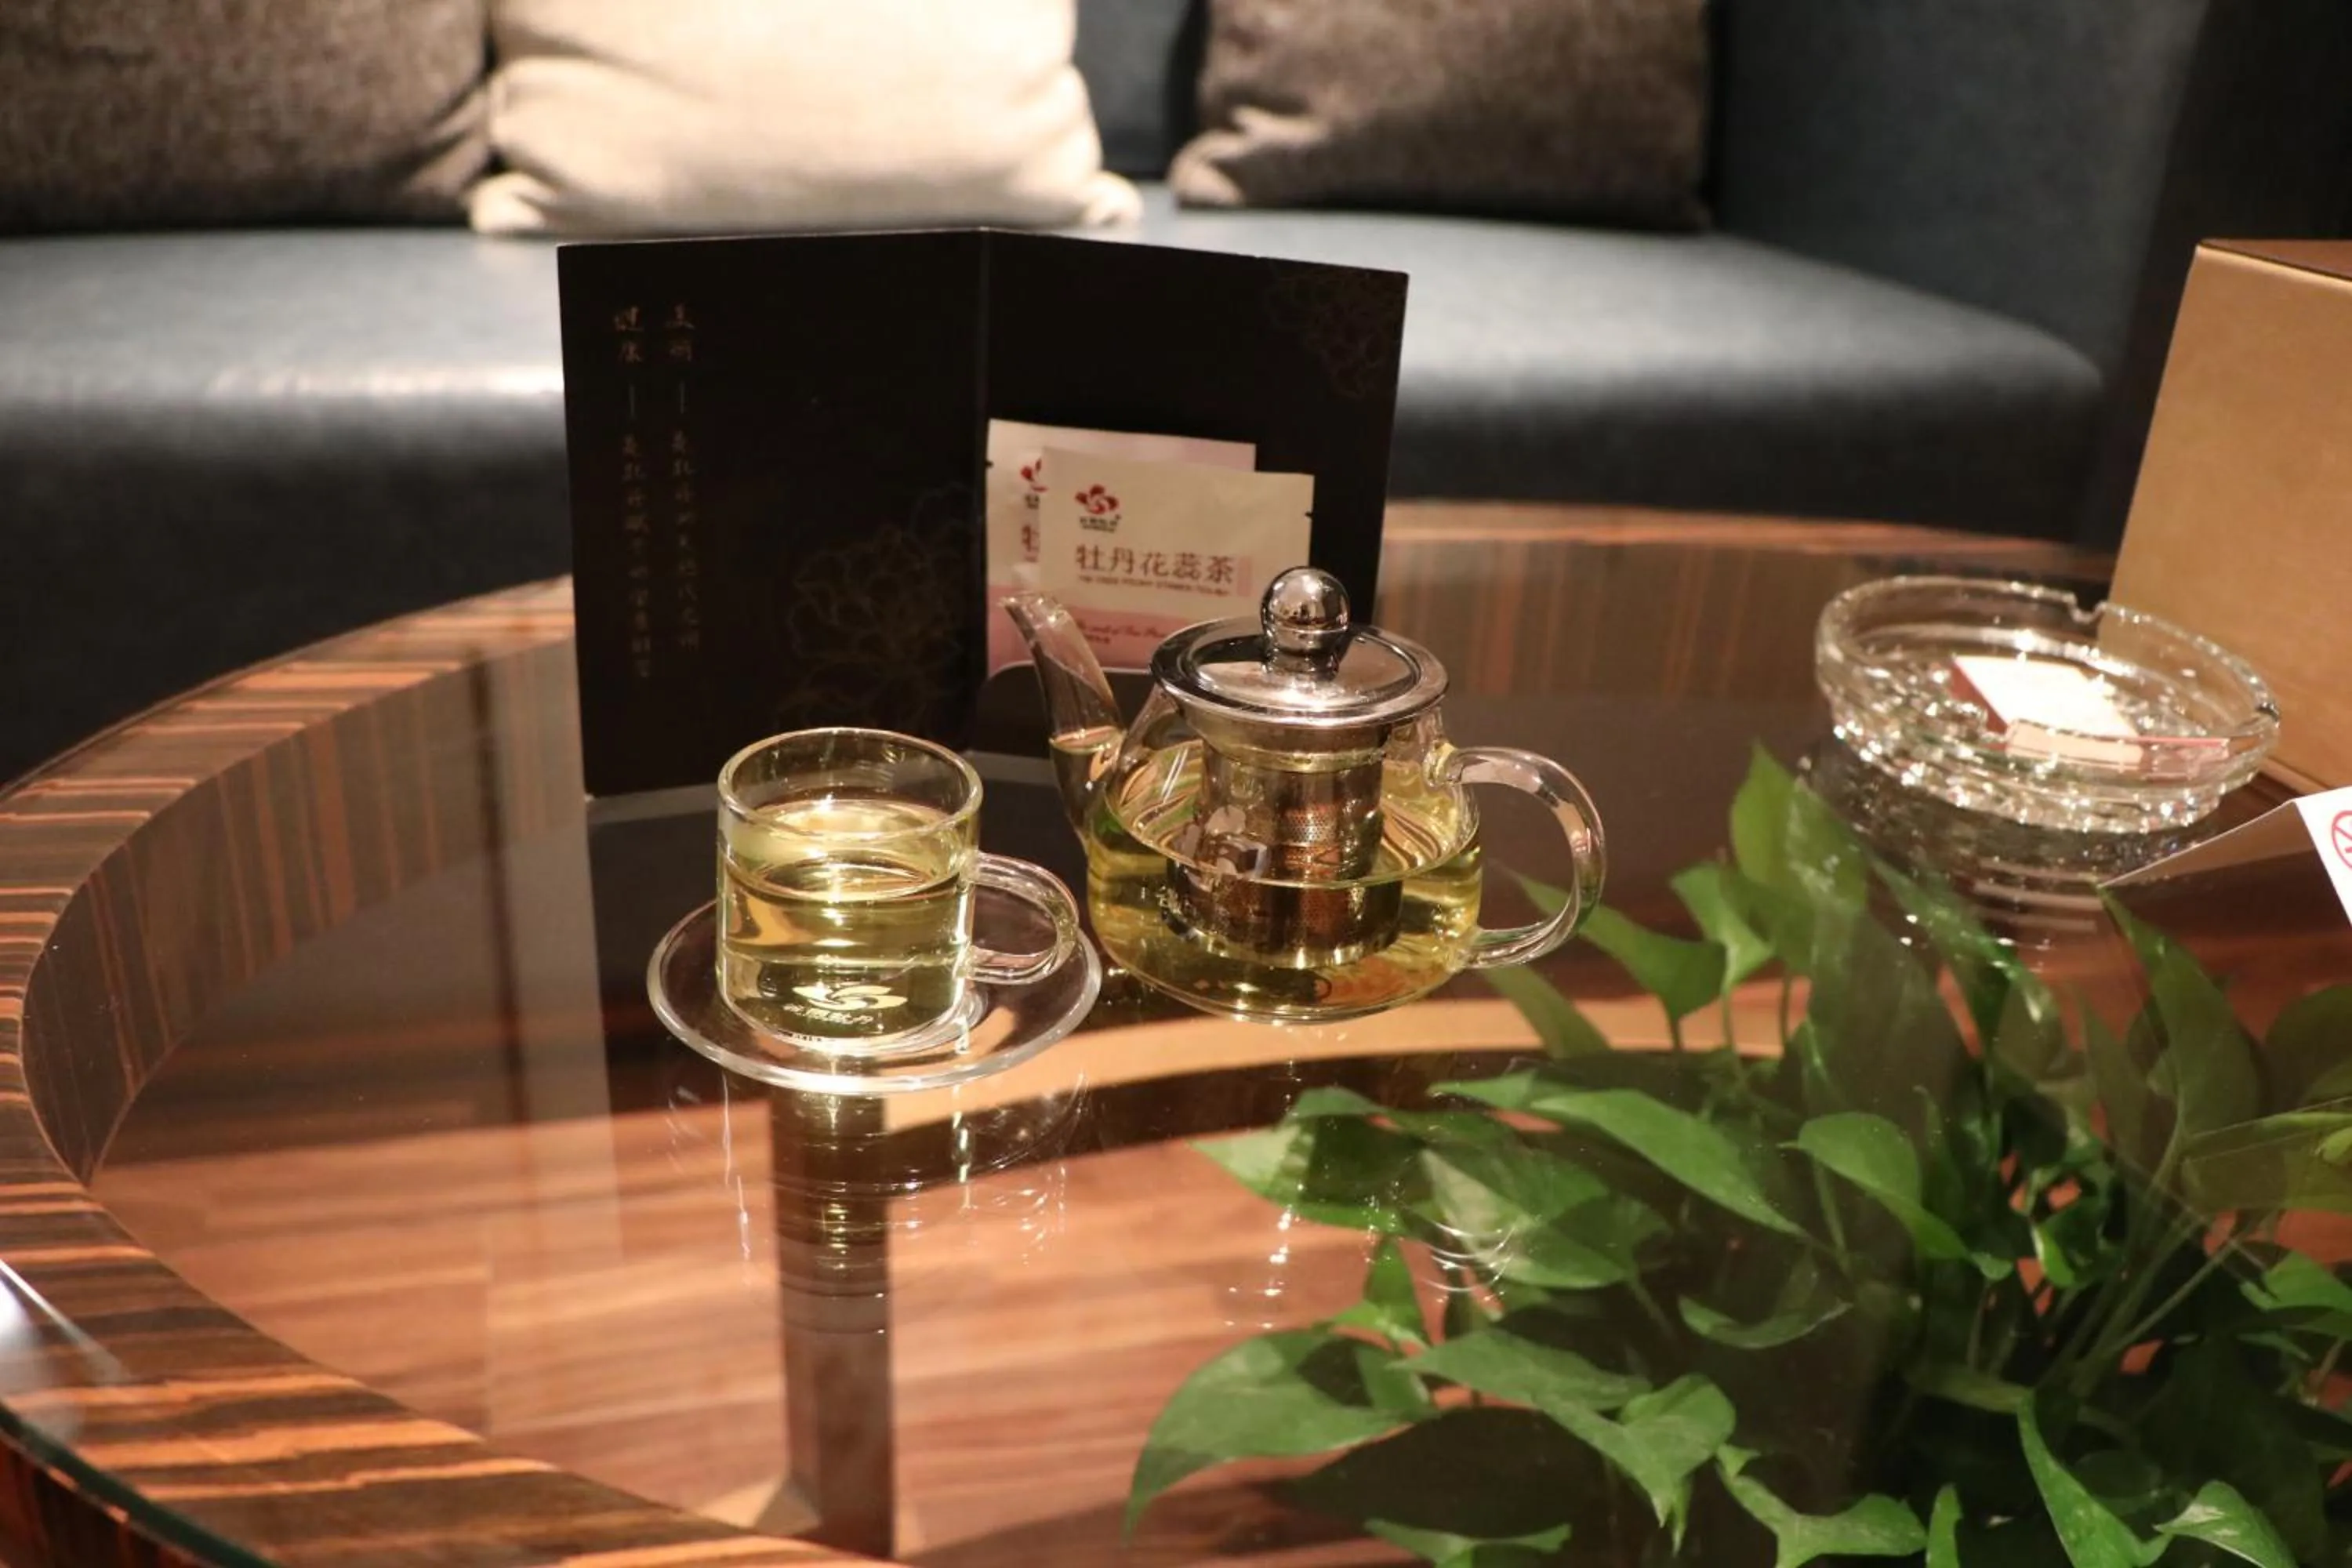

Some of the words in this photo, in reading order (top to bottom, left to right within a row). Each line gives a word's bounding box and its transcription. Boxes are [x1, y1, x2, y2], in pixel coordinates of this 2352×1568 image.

[1076, 544, 1234, 585] 牡丹花蕊茶
